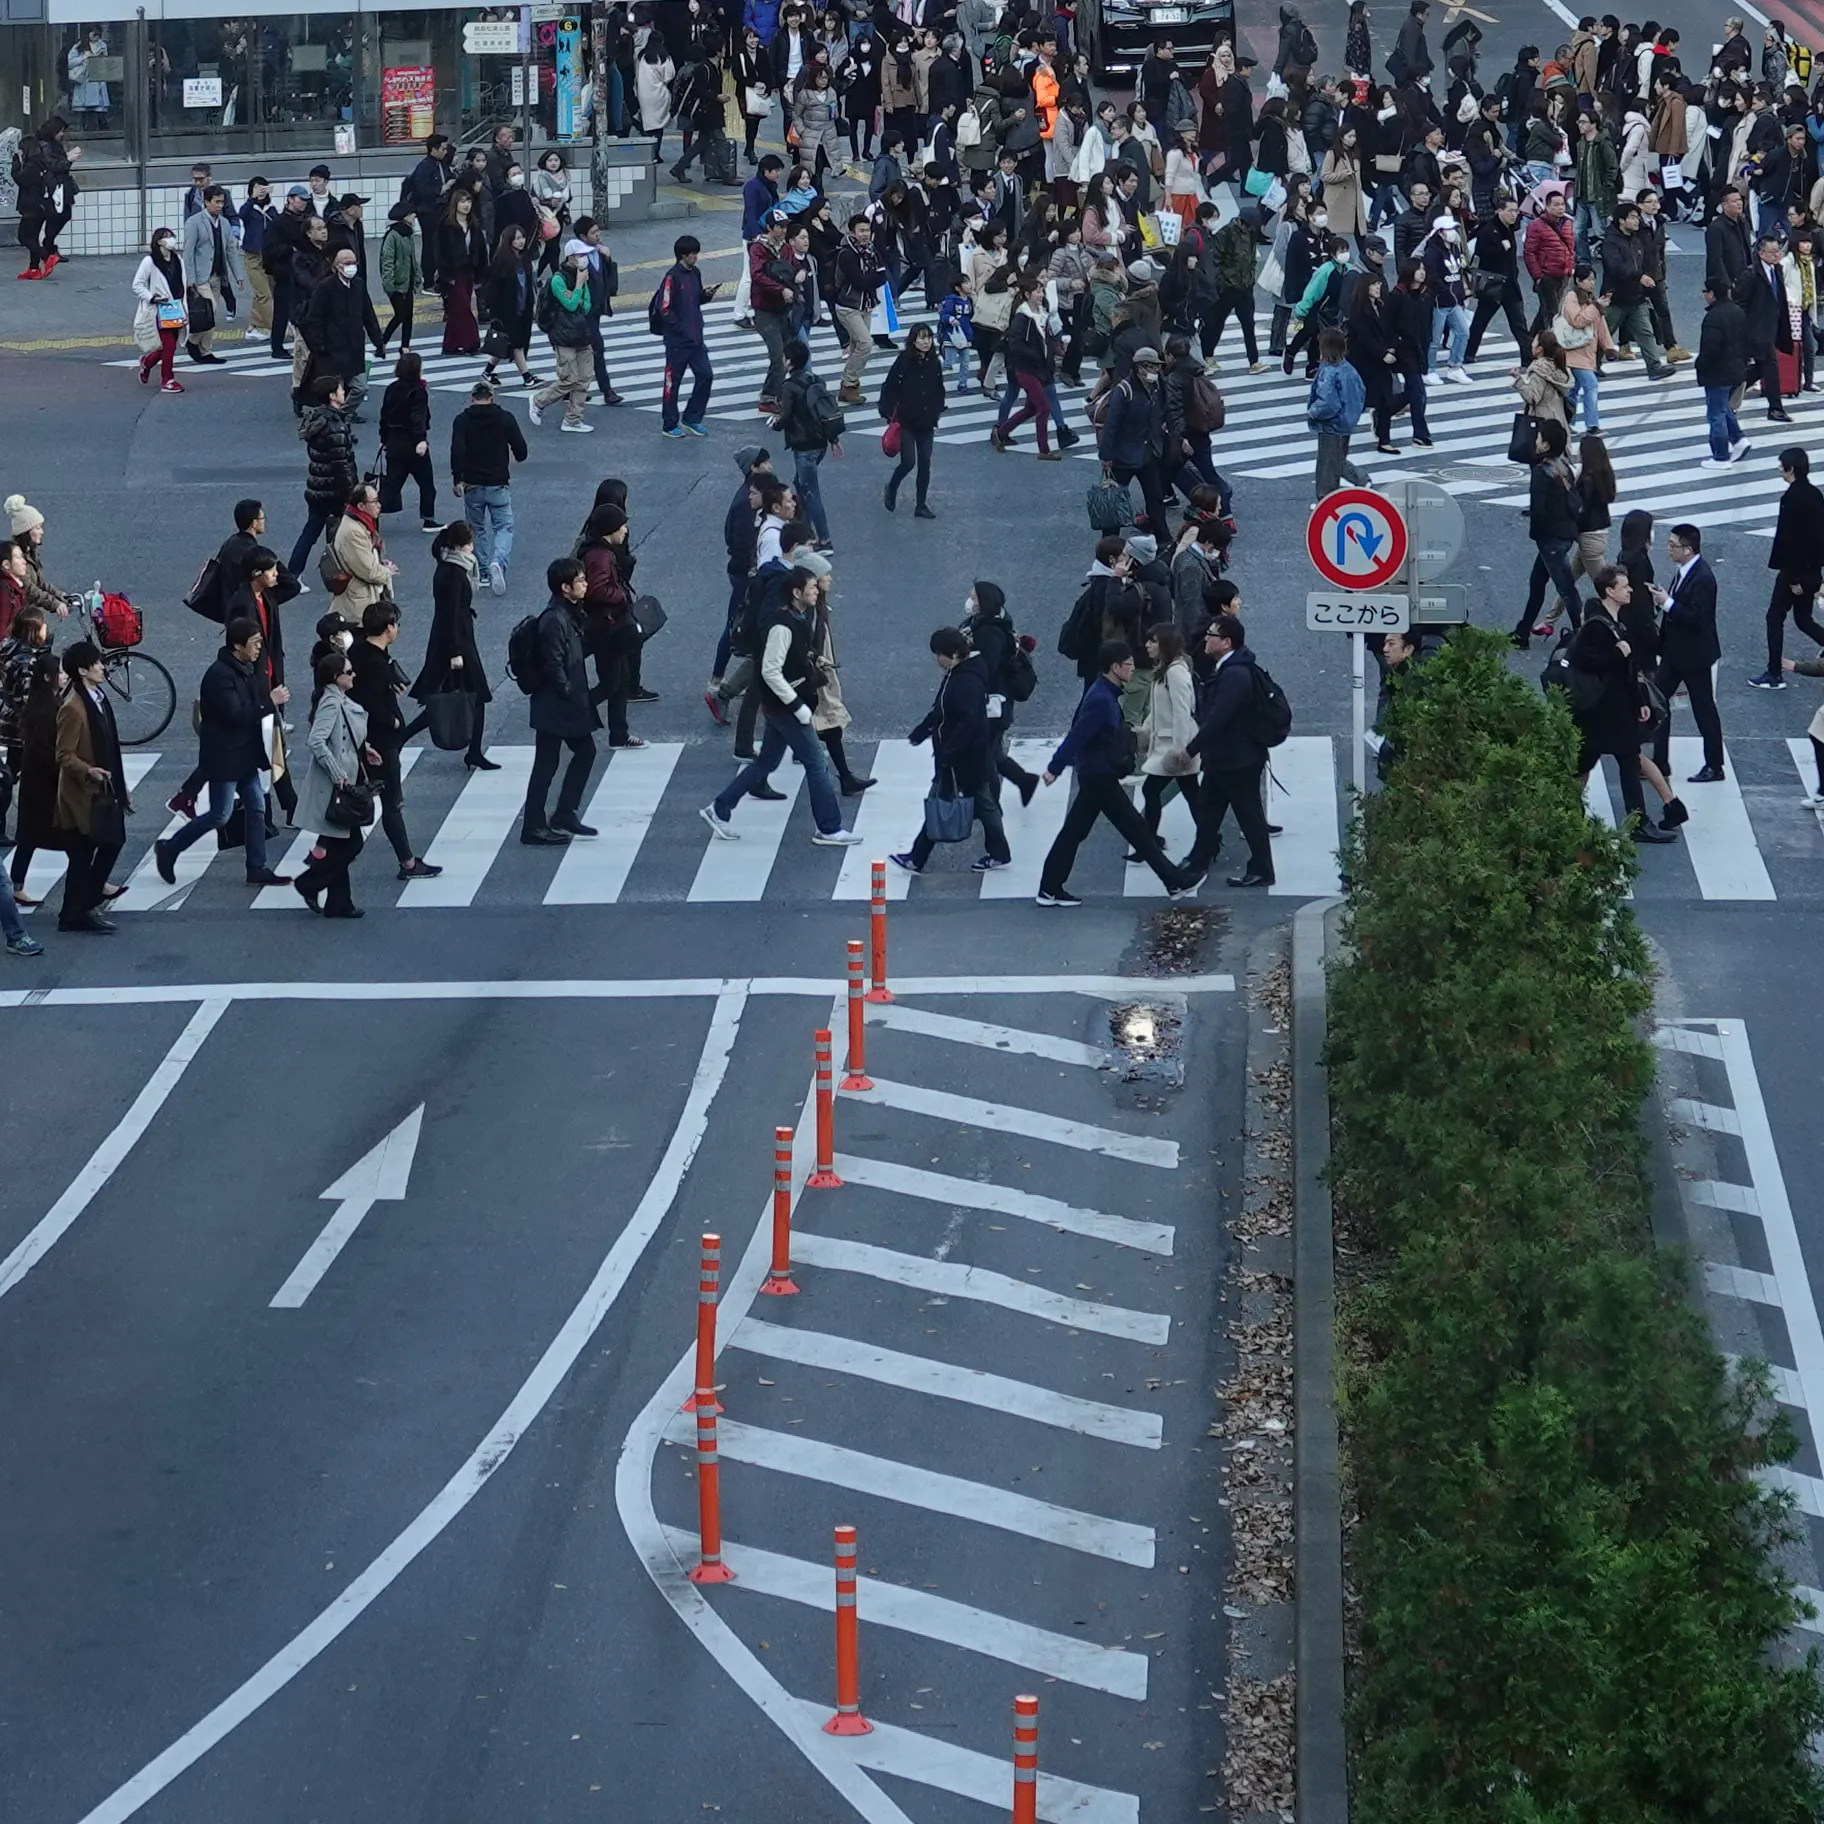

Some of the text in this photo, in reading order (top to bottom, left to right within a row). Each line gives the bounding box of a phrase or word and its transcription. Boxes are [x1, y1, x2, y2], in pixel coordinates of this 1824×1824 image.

[563, 21, 573, 31] 6
[1314, 603, 1400, 626] ここから
